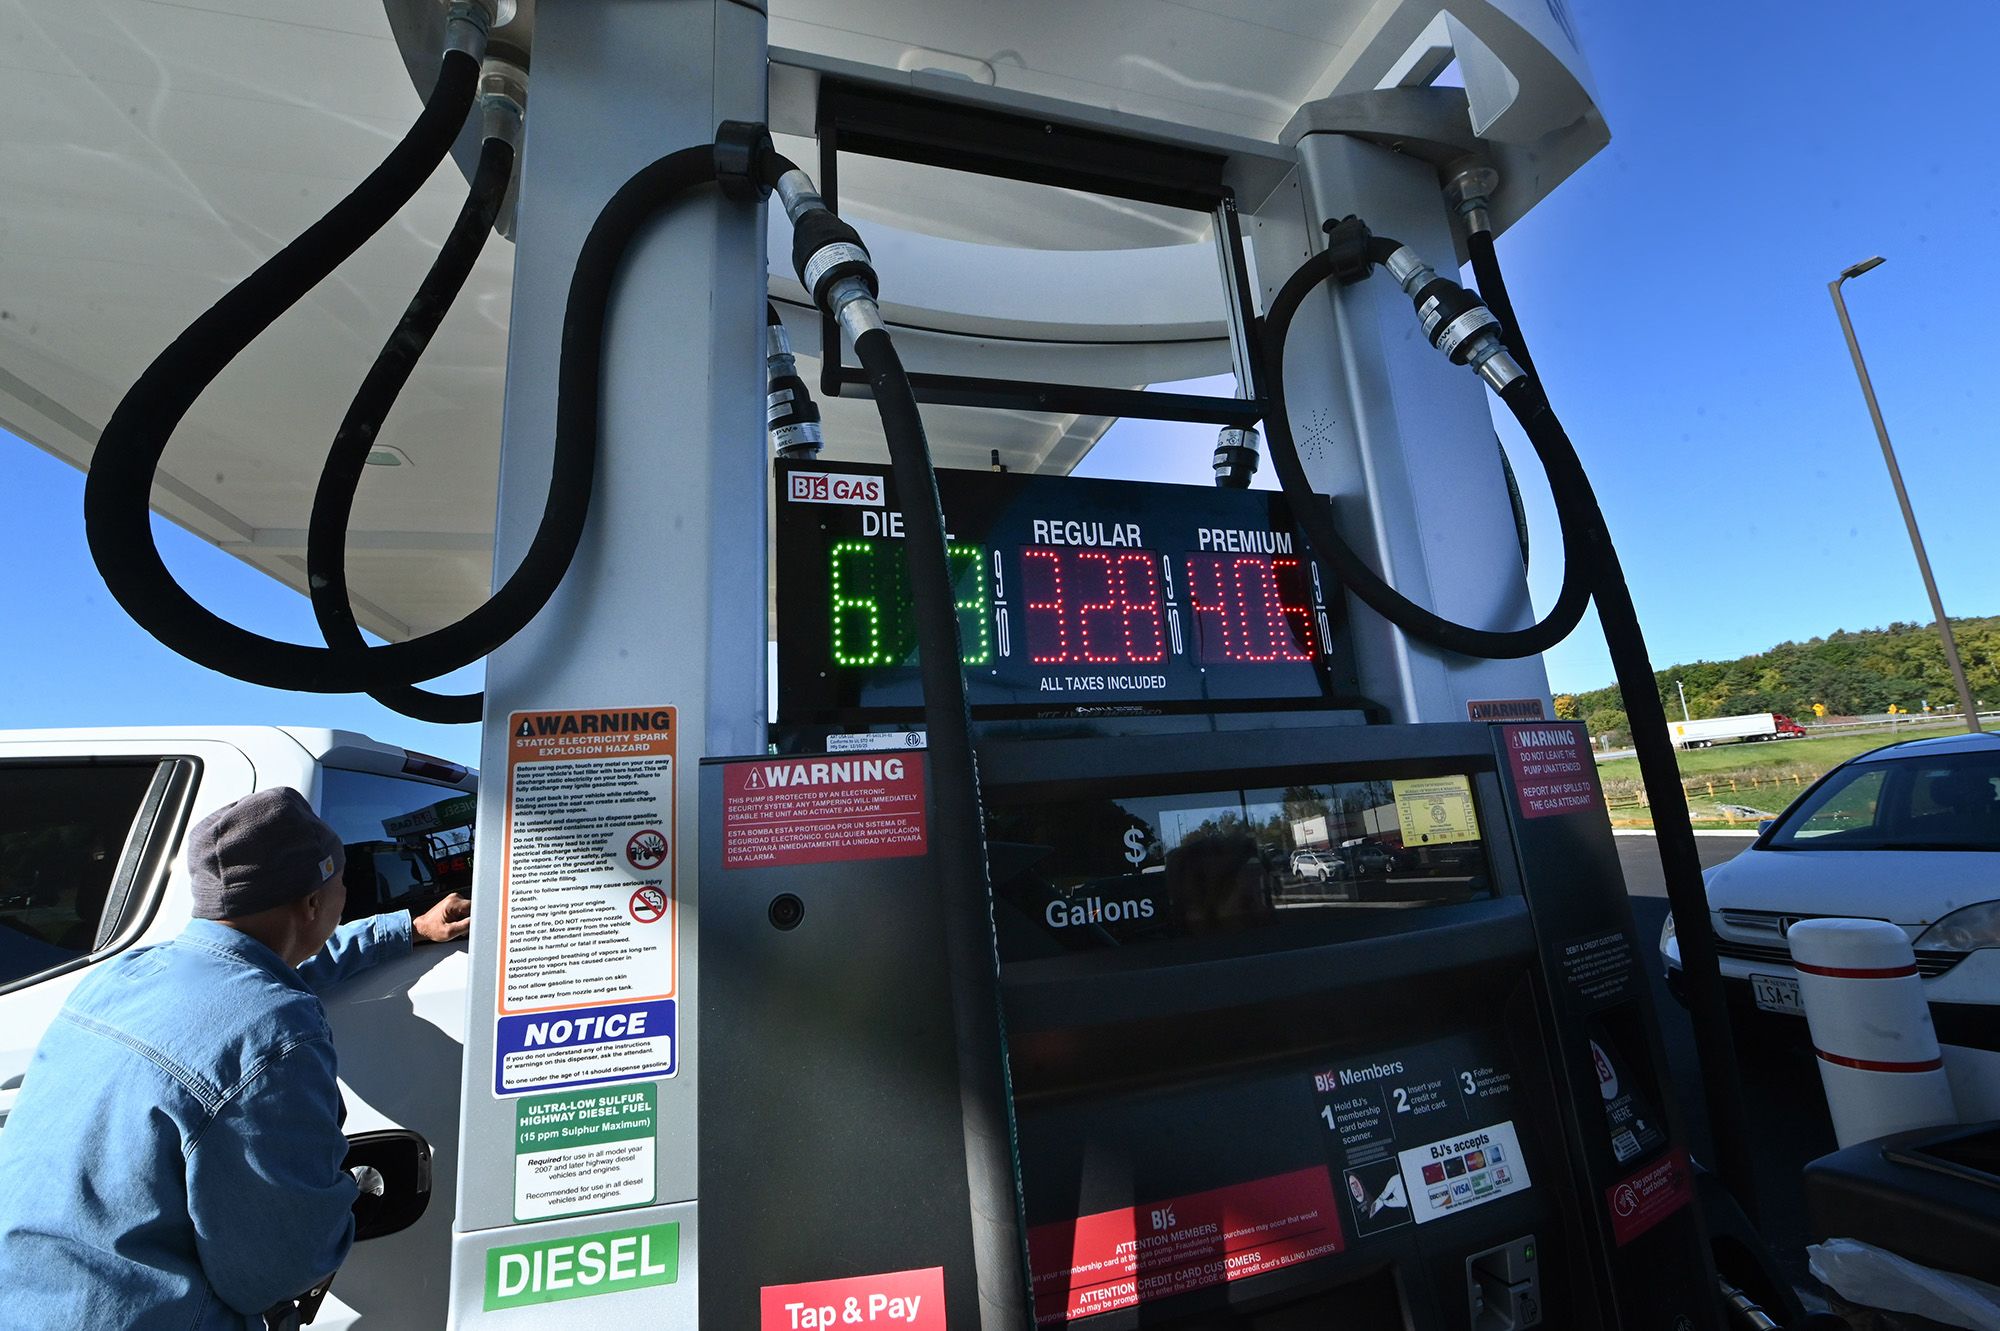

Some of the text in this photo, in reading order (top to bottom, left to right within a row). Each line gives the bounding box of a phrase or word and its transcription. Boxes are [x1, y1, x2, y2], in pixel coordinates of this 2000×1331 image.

[833, 480, 879, 501] GAS
[862, 510, 955, 540] DIE
[1033, 520, 1142, 547] REGULAR
[1198, 528, 1293, 554] PREMIUM
[994, 550, 1004, 598] 9
[1163, 555, 1174, 599] 9
[1311, 561, 1322, 603] 9
[1040, 676, 1166, 691] ALL TAXES INCLUDED
[1480, 702, 1540, 717] WARNING
[537, 711, 670, 735] WARNING
[516, 732, 668, 747] STATIC ELECTRICITY SPARK
[1519, 730, 1575, 747] WARNING
[539, 743, 650, 756] EXPLOSION HAZARD
[1521, 750, 1576, 762] DO NOT LEAVE THE
[765, 759, 904, 787] WARNING
[1524, 762, 1581, 775] PUMP UNATTENDED
[745, 795, 766, 803] PUMP
[766, 794, 774, 802] IS
[775, 792, 817, 801] PROTECTED
[841, 787, 885, 797] ELECTRONIC
[1523, 782, 1590, 797] REPORT ANY SPILLS TO
[728, 803, 763, 813] SECURITY
[812, 798, 852, 807] TAMPERING
[871, 794, 917, 803] IMMEDIATELY
[728, 812, 758, 821] DISABLE
[775, 810, 791, 818] UNIT
[808, 806, 842, 815] ACTIVATE
[1530, 795, 1591, 811] THE GAS ATTENDANT
[728, 829, 746, 837] ESTA
[747, 828, 774, 836] BOMBA
[794, 823, 836, 833] PROTEGIDA
[837, 822, 852, 830] POR
[865, 819, 896, 828] SISTEMA
[897, 818, 906, 826] DE
[728, 836, 770, 846] SEGURIDAD
[824, 829, 865, 839] CUALQUIER
[778, 840, 840, 850] INMEDIATAMENTE
[852, 837, 880, 845] UNIDAD
[1124, 825, 1147, 867] $
[1046, 897, 1154, 927] Gallons
[524, 1012, 648, 1047] NOTICE
[590, 1067, 611, 1075] should
[612, 1064, 640, 1073] dispense
[641, 1061, 670, 1070] gasoline.
[1339, 1061, 1404, 1086] Members
[1407, 1080, 1442, 1094] Insert your
[1461, 1071, 1476, 1095] 3
[528, 1092, 644, 1115] ULTRA-LOW SULFUR
[1334, 1098, 1368, 1112] Hold BJ's
[1393, 1088, 1411, 1113] 2
[1411, 1094, 1430, 1104] credit
[520, 1101, 652, 1127] HIGHWAY DIESEL FUEL
[1321, 1105, 1335, 1130] 1
[1337, 1106, 1380, 1123] membership
[1414, 1105, 1431, 1115] debit
[1612, 1105, 1632, 1123] HERE
[520, 1117, 650, 1144] (15 ppm Sulphur Maximum)
[1340, 1118, 1378, 1133] card below
[1342, 1131, 1373, 1144] scanner.
[1431, 1134, 1490, 1159] BJ's accepts
[527, 1156, 562, 1167] Required
[562, 1154, 572, 1162] for
[573, 1153, 586, 1161] use
[605, 1147, 626, 1156] model
[628, 1146, 642, 1154] year
[534, 1154, 635, 1174] 2007 and later highway diesel
[1453, 1183, 1470, 1196] VISA
[1104, 1257, 1119, 1267] card
[1223, 1228, 1255, 1240] purchases
[1115, 1223, 1218, 1255] ATTENTION MEMBERS
[497, 1234, 666, 1298] DIESEL
[1226, 1243, 1336, 1279] your credit card's BILLING ADDRESS
[1080, 1251, 1261, 1304] ATTENTION CREDIT CARD CUSTOMERS
[785, 1293, 921, 1331] Tap & Pay
